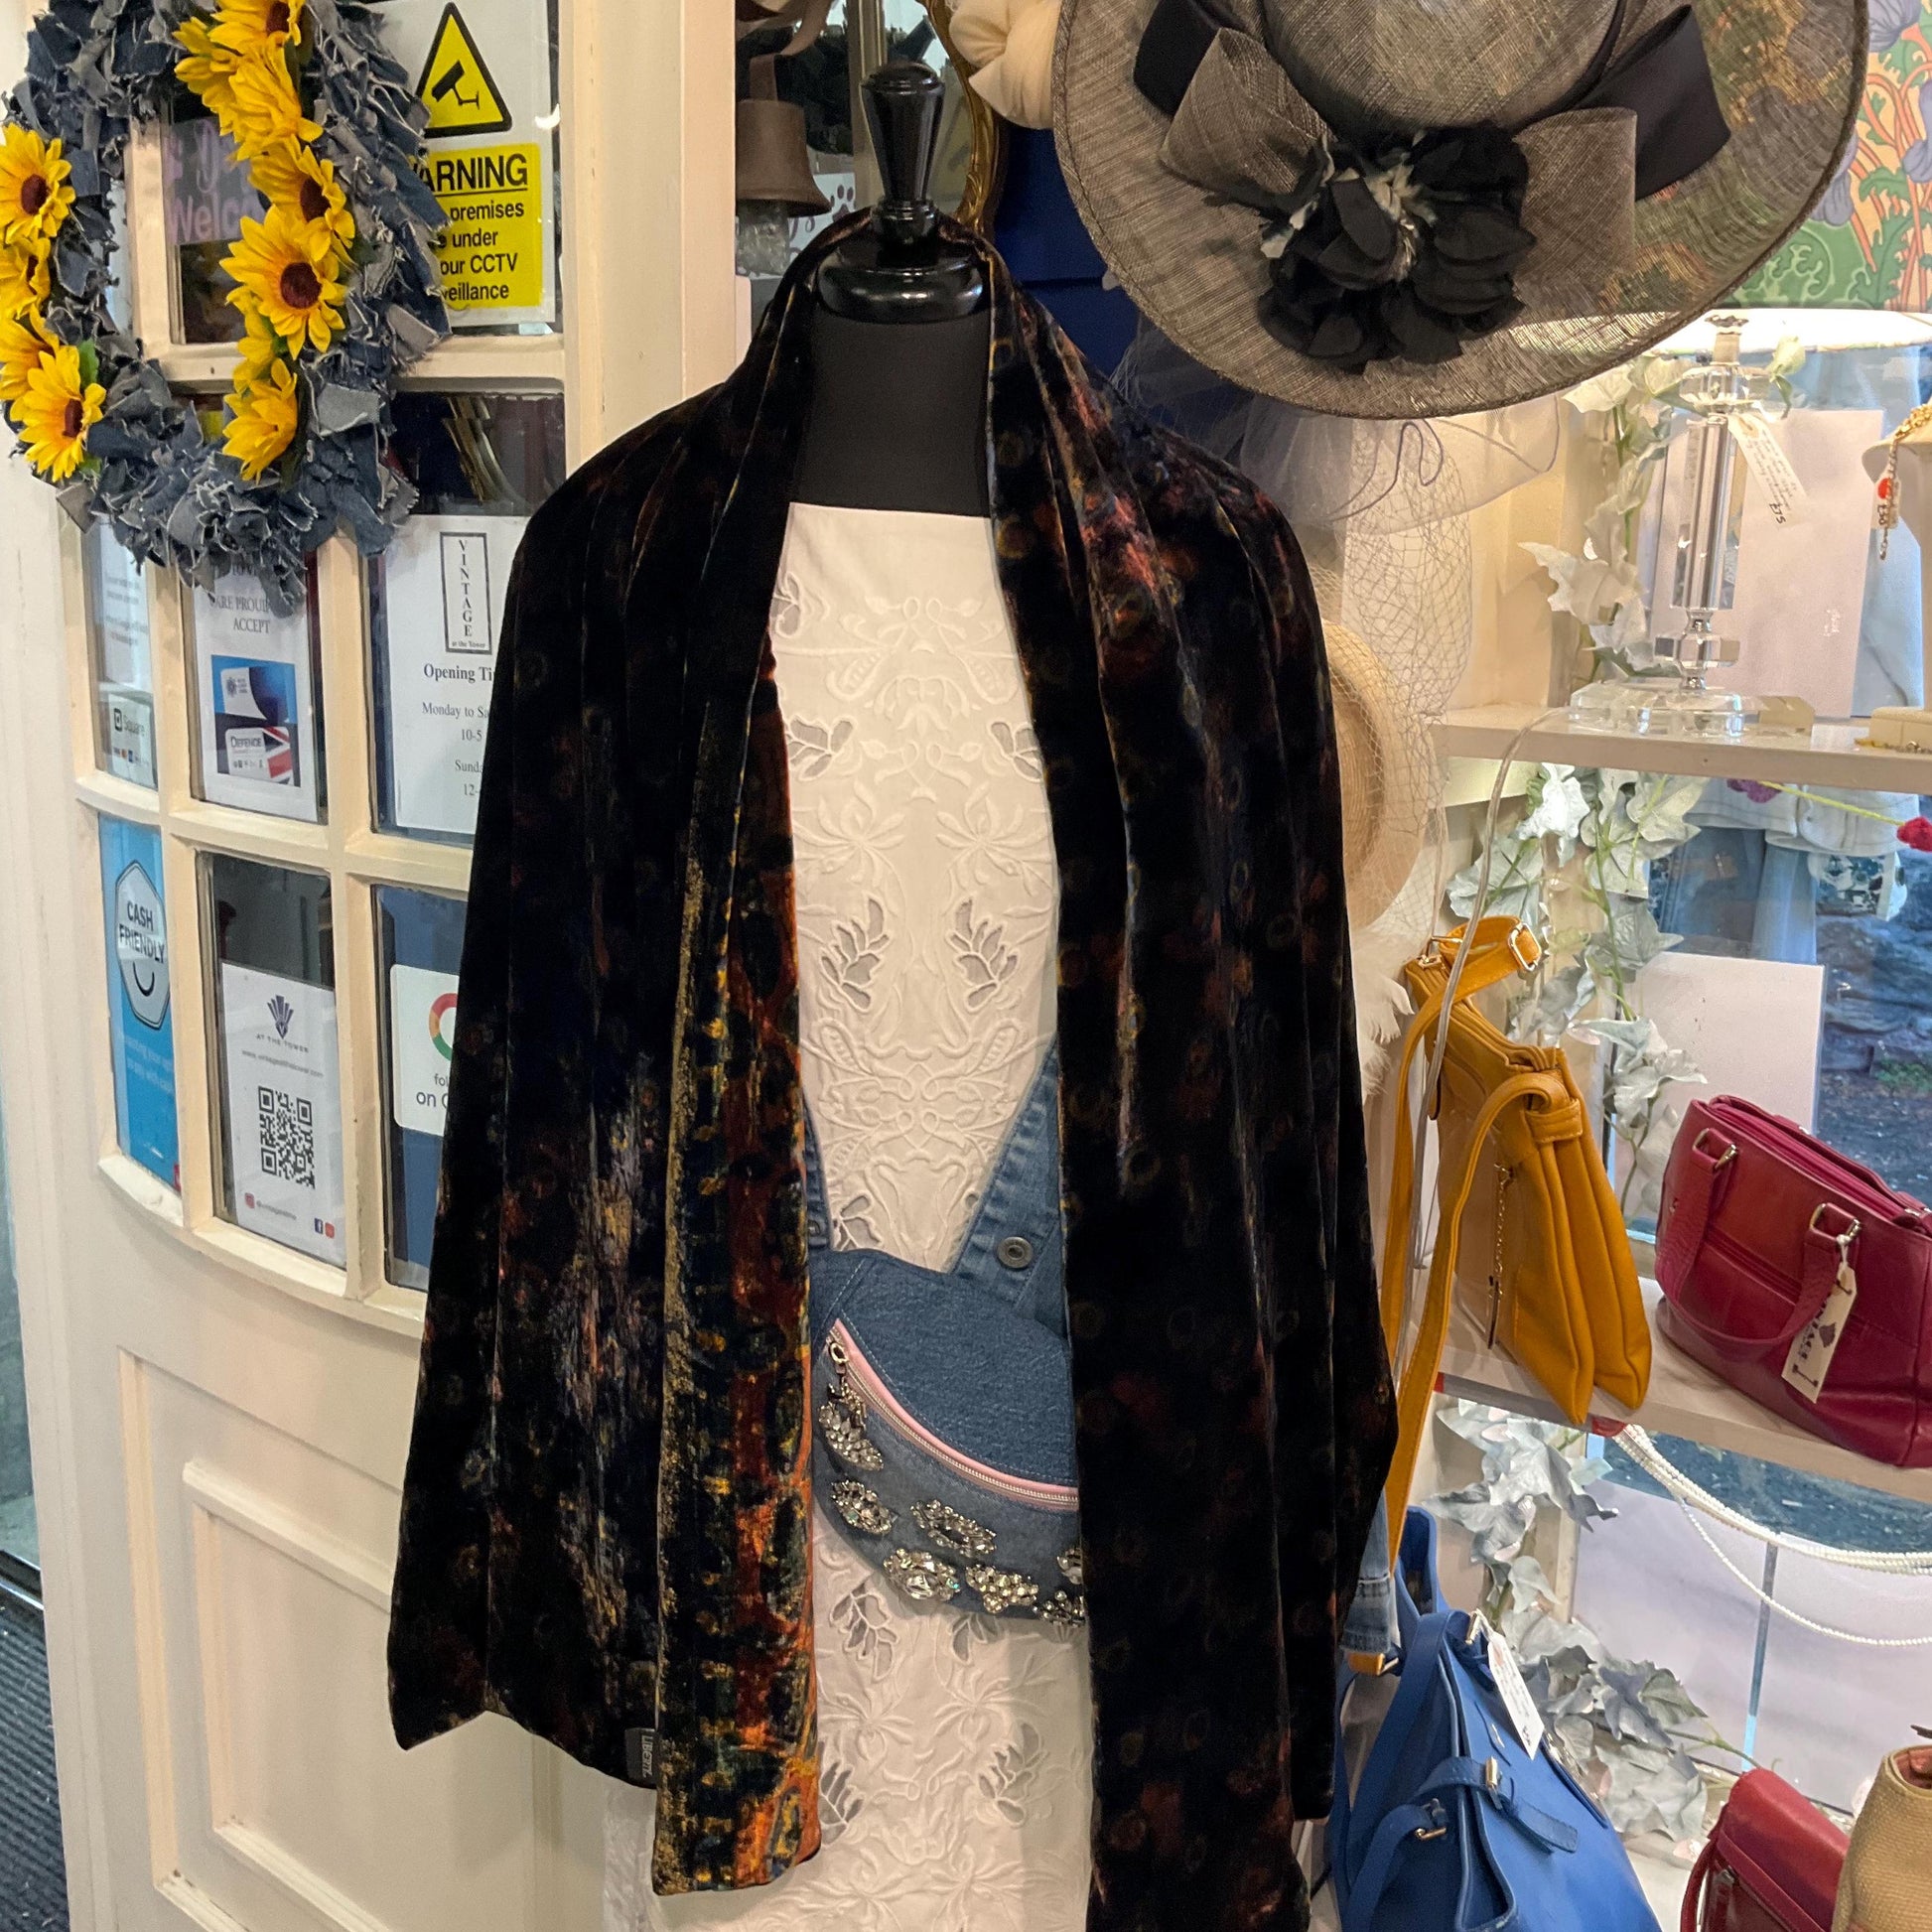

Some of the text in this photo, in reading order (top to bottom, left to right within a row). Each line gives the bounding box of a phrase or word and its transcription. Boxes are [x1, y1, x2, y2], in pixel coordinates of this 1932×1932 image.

[413, 153, 527, 193] ARNING
[450, 200, 524, 221] premises
[452, 227, 498, 247] under
[471, 252, 518, 273] CCTV
[458, 539, 473, 637] VINTAGE
[233, 617, 270, 633] ACCEPT
[423, 662, 476, 683] Opening
[422, 701, 461, 720] Monday
[465, 706, 475, 718] to
[461, 728, 483, 743] 10-5
[126, 899, 154, 932] CASH
[119, 922, 165, 964] FRIENDLY
[416, 1091, 437, 1108] on
